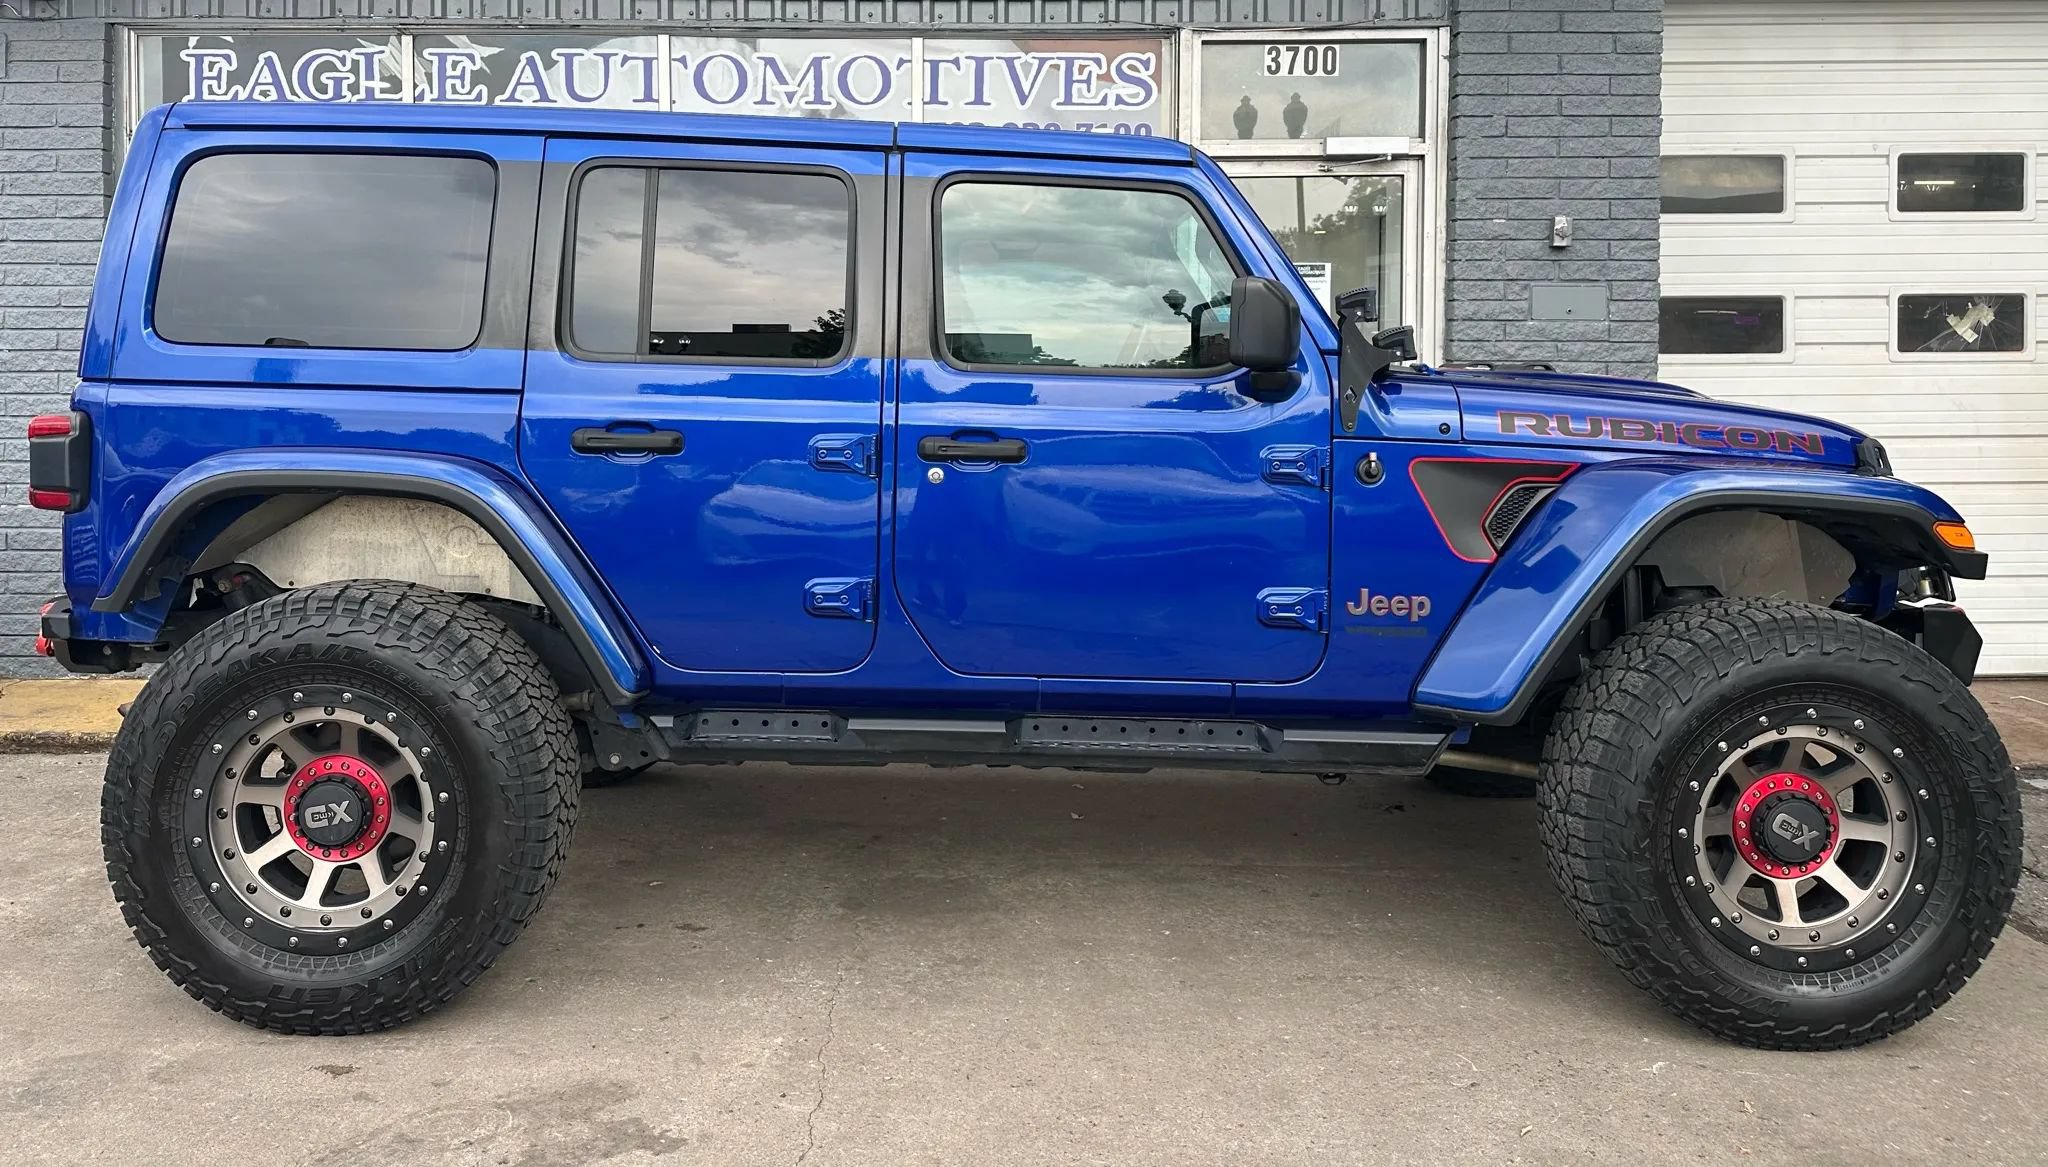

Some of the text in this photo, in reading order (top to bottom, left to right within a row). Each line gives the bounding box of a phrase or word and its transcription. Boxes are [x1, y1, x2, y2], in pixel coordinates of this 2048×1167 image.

[182, 48, 1159, 110] EAGLE AUTOMOTIVES
[1266, 45, 1338, 76] 3700
[1498, 410, 1825, 455] RUBICON
[1346, 587, 1431, 622] Jeep
